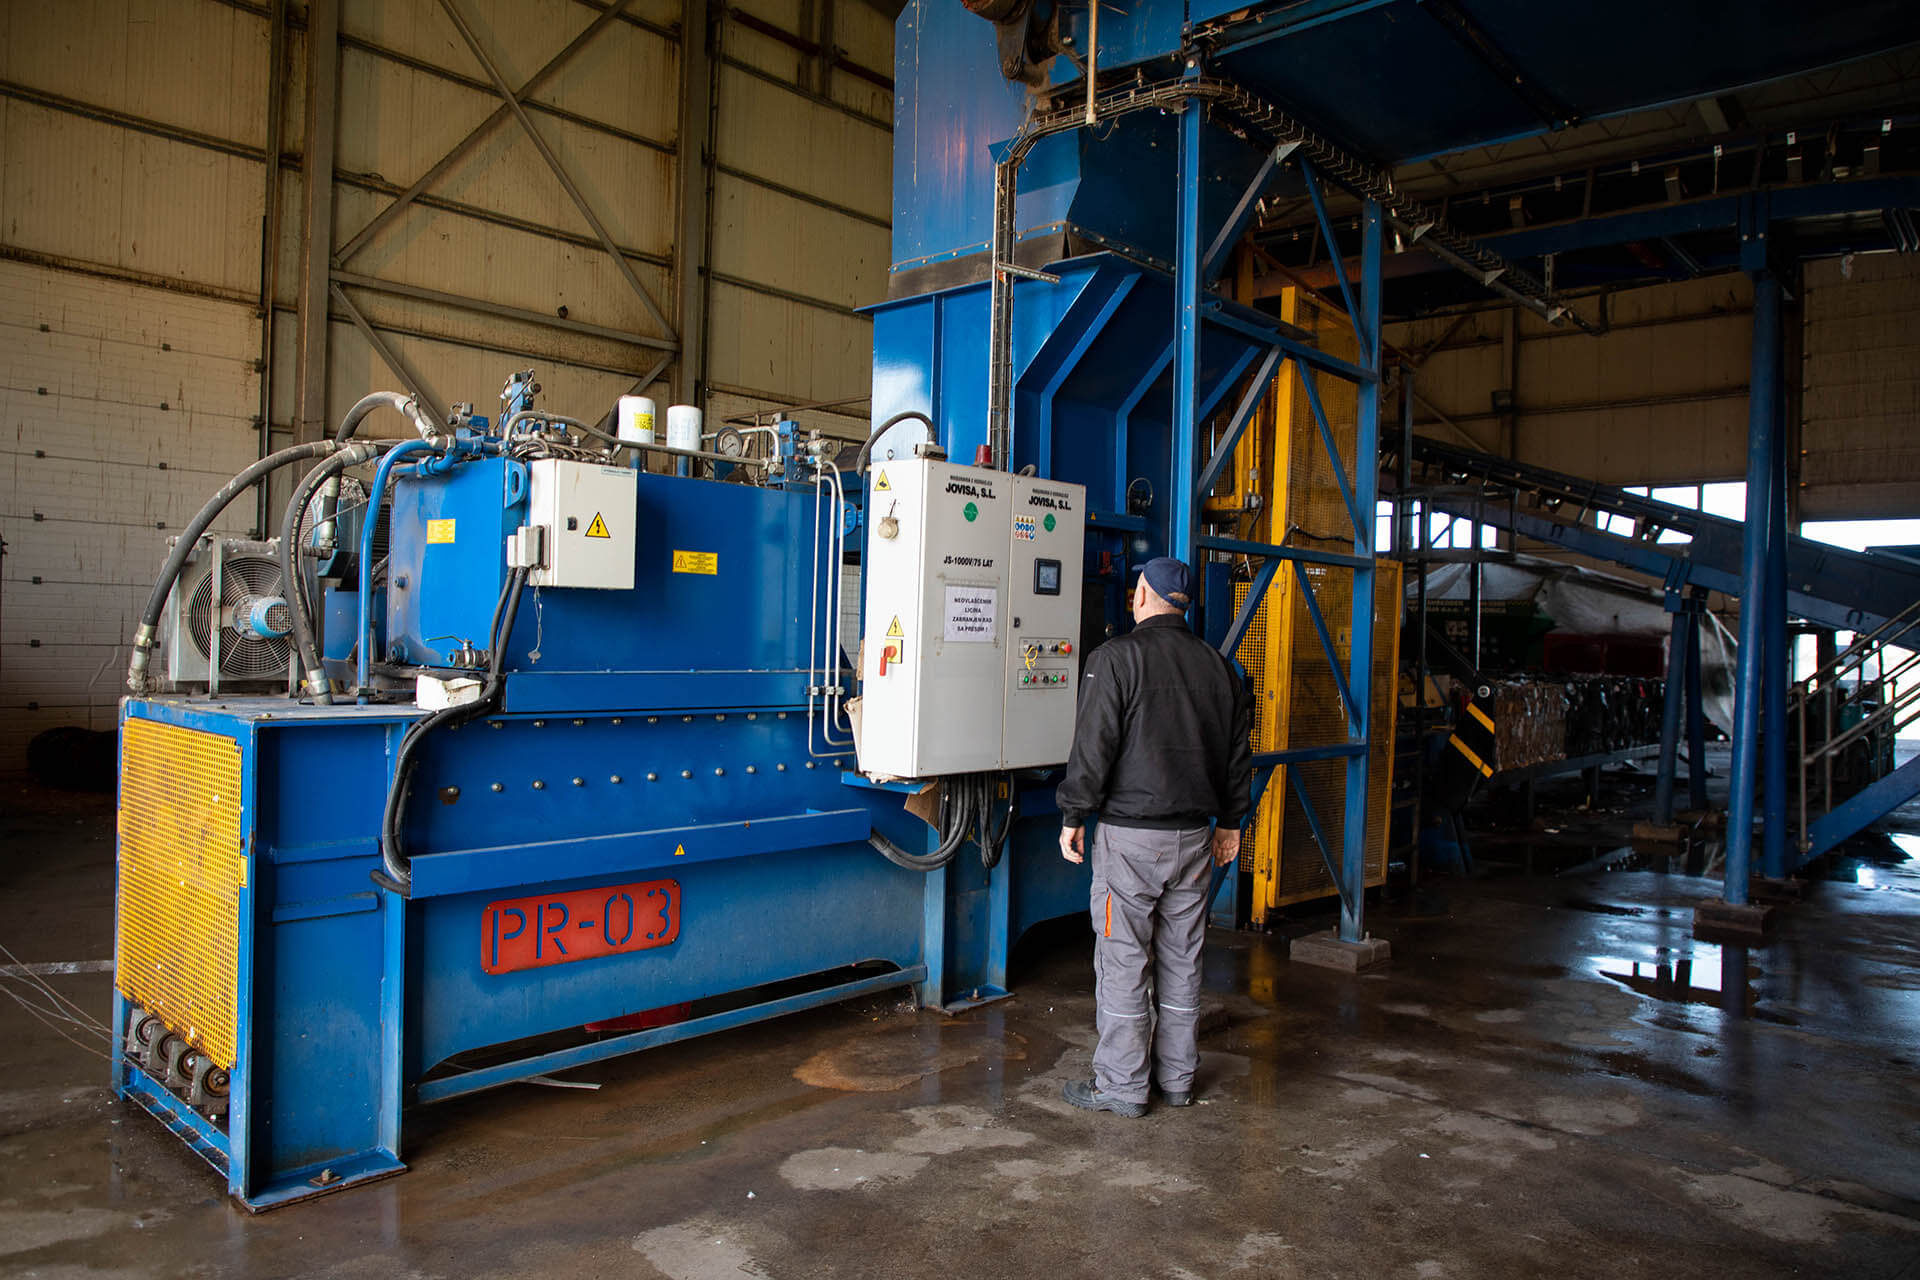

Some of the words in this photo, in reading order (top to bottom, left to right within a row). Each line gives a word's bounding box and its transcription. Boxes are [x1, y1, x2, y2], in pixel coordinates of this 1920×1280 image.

[945, 482, 980, 499] JOVISA,
[981, 487, 996, 500] S.L.
[1028, 495, 1057, 511] JOVISA,
[1058, 499, 1072, 511] S.L.
[982, 559, 994, 568] LAT
[491, 887, 673, 967] PR-03
